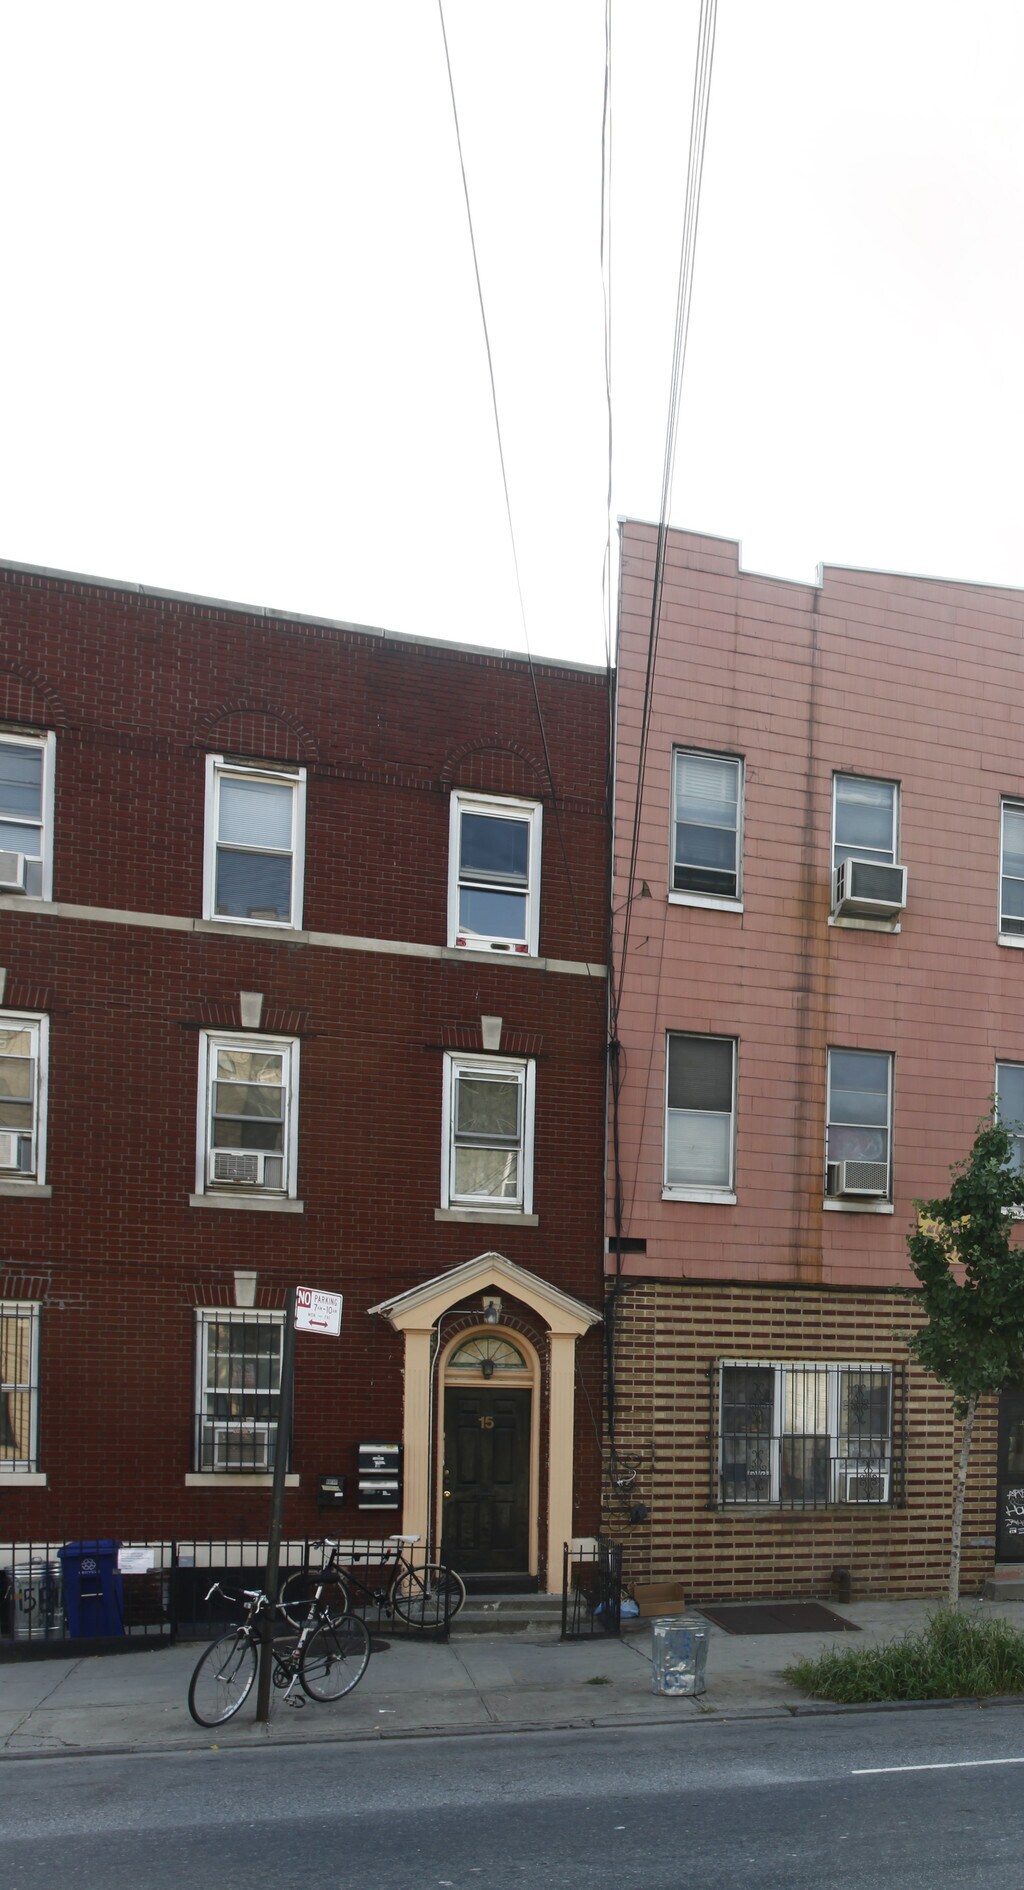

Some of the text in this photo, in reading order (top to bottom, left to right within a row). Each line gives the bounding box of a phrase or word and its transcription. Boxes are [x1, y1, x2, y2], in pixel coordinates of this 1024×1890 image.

[298, 1290, 338, 1307] NO PARKING
[478, 1415, 495, 1429] 15
